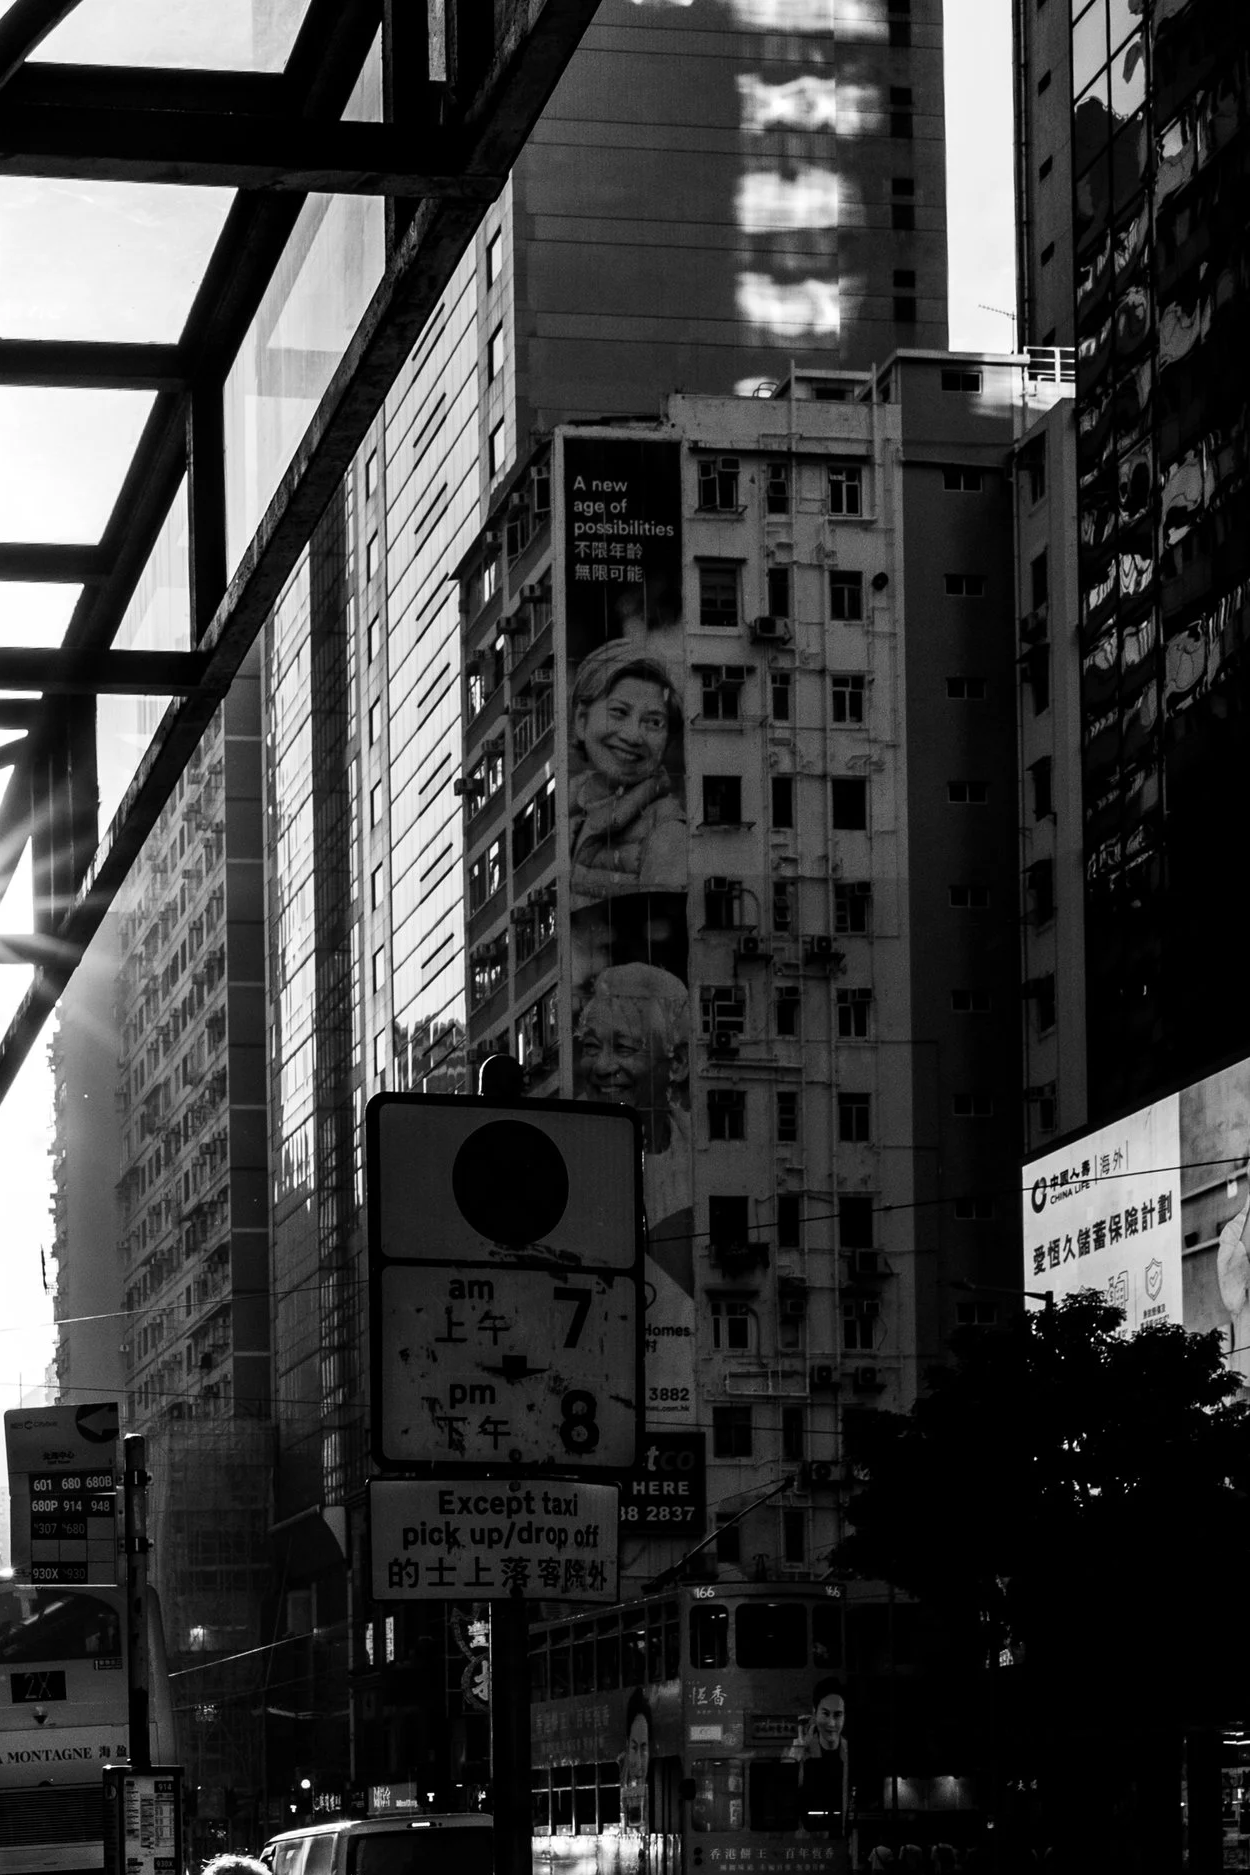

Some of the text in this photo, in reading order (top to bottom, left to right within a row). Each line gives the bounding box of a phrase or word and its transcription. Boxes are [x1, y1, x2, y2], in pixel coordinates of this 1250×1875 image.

[573, 475, 628, 492] A new
[573, 498, 628, 516] age of
[574, 519, 675, 538] possibilities
[574, 563, 644, 583] 無限可能
[1049, 1181, 1091, 1205] CHINA LIFE
[449, 1278, 493, 1300] am
[435, 1308, 510, 1346] 上午
[554, 1287, 592, 1348] 7
[449, 1383, 496, 1410] pm
[559, 1389, 599, 1454] 8
[435, 1416, 512, 1451] 下午
[33, 1475, 112, 1492] 601 680 680B
[632, 1481, 690, 1496] HERE
[32, 1500, 110, 1512] 680P 914 948
[439, 1490, 578, 1519] Except taxi
[646, 1506, 696, 1521] 2837
[402, 1521, 599, 1550] pick up/drop off
[32, 1567, 59, 1580] 930X
[388, 1557, 607, 1593] 的士上落客除外
[693, 1586, 715, 1600] 166
[24, 1671, 54, 1700] 2X
[7, 1747, 93, 1764] MONTAGNE
[158, 1782, 172, 1791] 914
